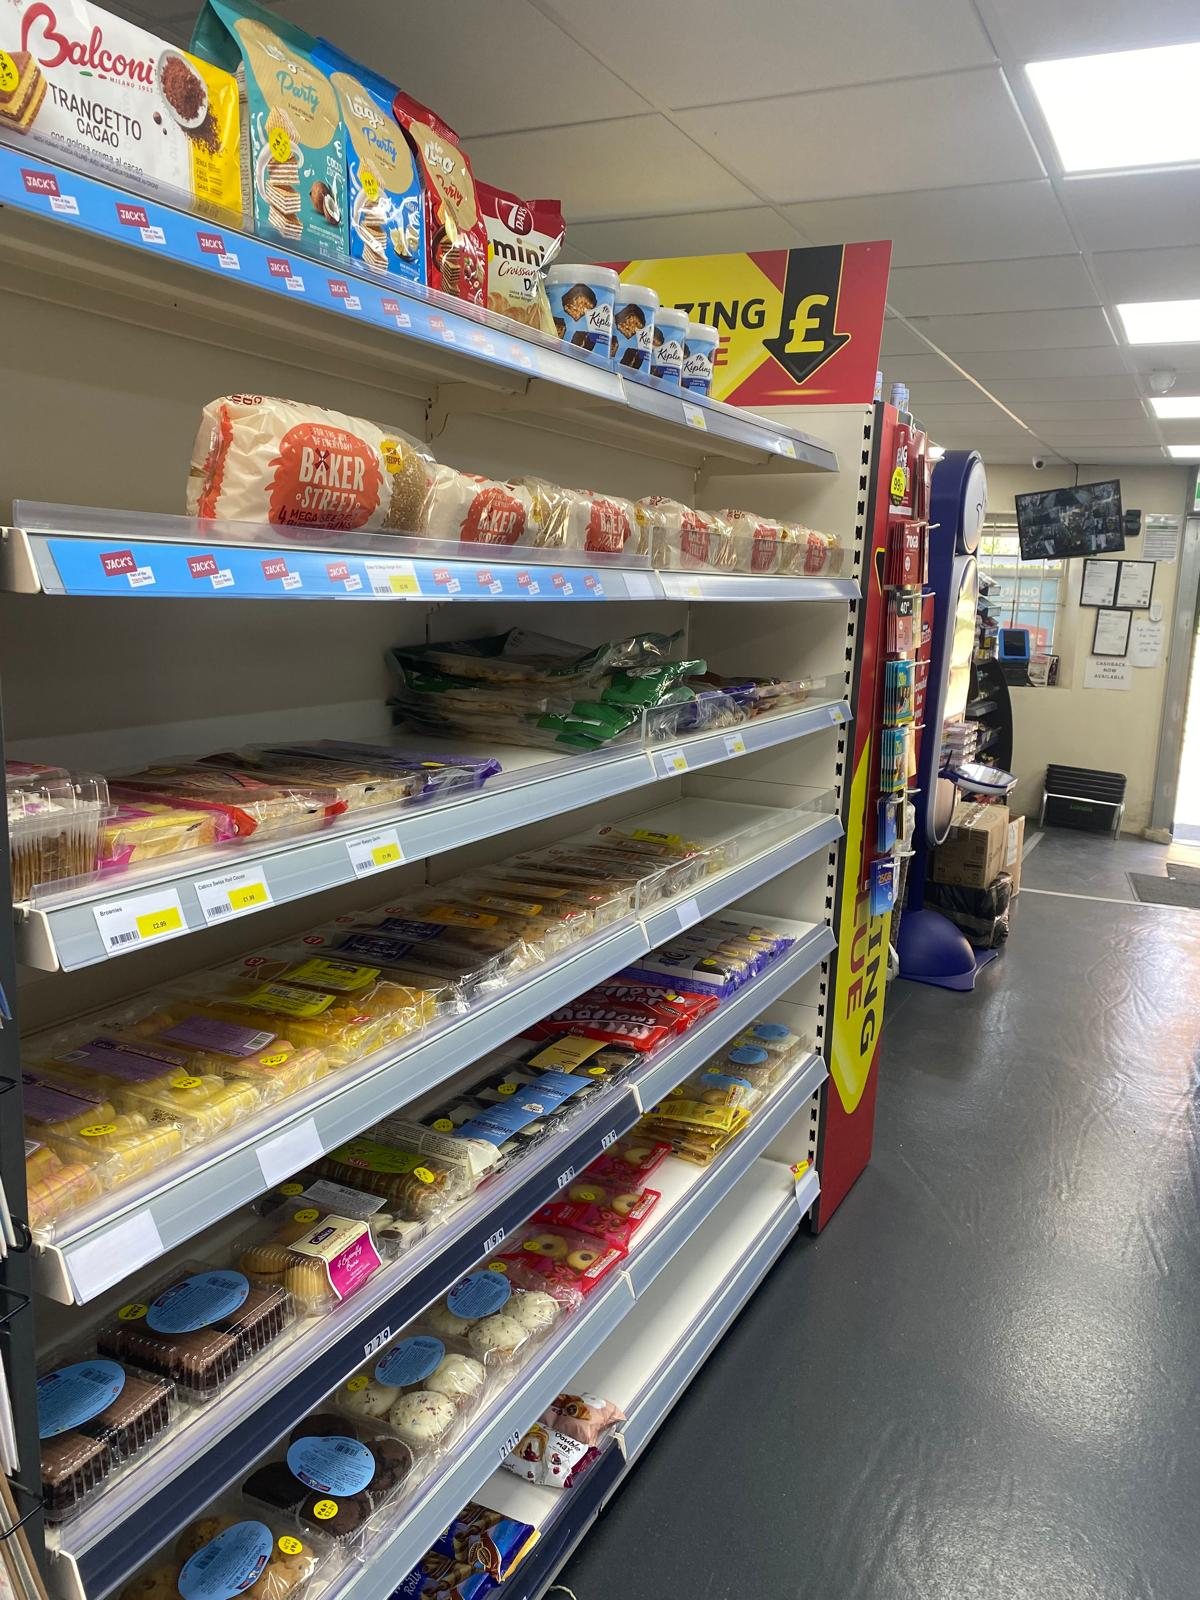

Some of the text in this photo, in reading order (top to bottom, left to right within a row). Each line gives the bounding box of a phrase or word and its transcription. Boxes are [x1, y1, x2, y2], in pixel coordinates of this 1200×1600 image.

[21, 2, 154, 84] Balconi
[276, 70, 320, 115] Party
[48, 82, 142, 141] TRANCETTO
[76, 118, 119, 149] CACAO
[362, 127, 398, 163] Party
[26, 175, 57, 192] JACK'S
[119, 209, 147, 223] JACK'S
[200, 237, 224, 250] JACK'S
[270, 263, 290, 275] JACK'S
[498, 260, 536, 278] Croissan
[683, 360, 711, 377] Kipling
[299, 447, 366, 492] BAKER
[300, 485, 357, 514] STREET
[290, 508, 318, 522] MEGA
[477, 508, 517, 534] BAKER
[105, 556, 133, 571] JACK'S
[191, 560, 216, 573] JACK'S
[265, 563, 286, 575] JACK'S
[99, 906, 123, 917] Brownies
[152, 919, 167, 930] £2.99
[861, 920, 883, 1057] ING
[404, 1570, 422, 1596] Rolls
